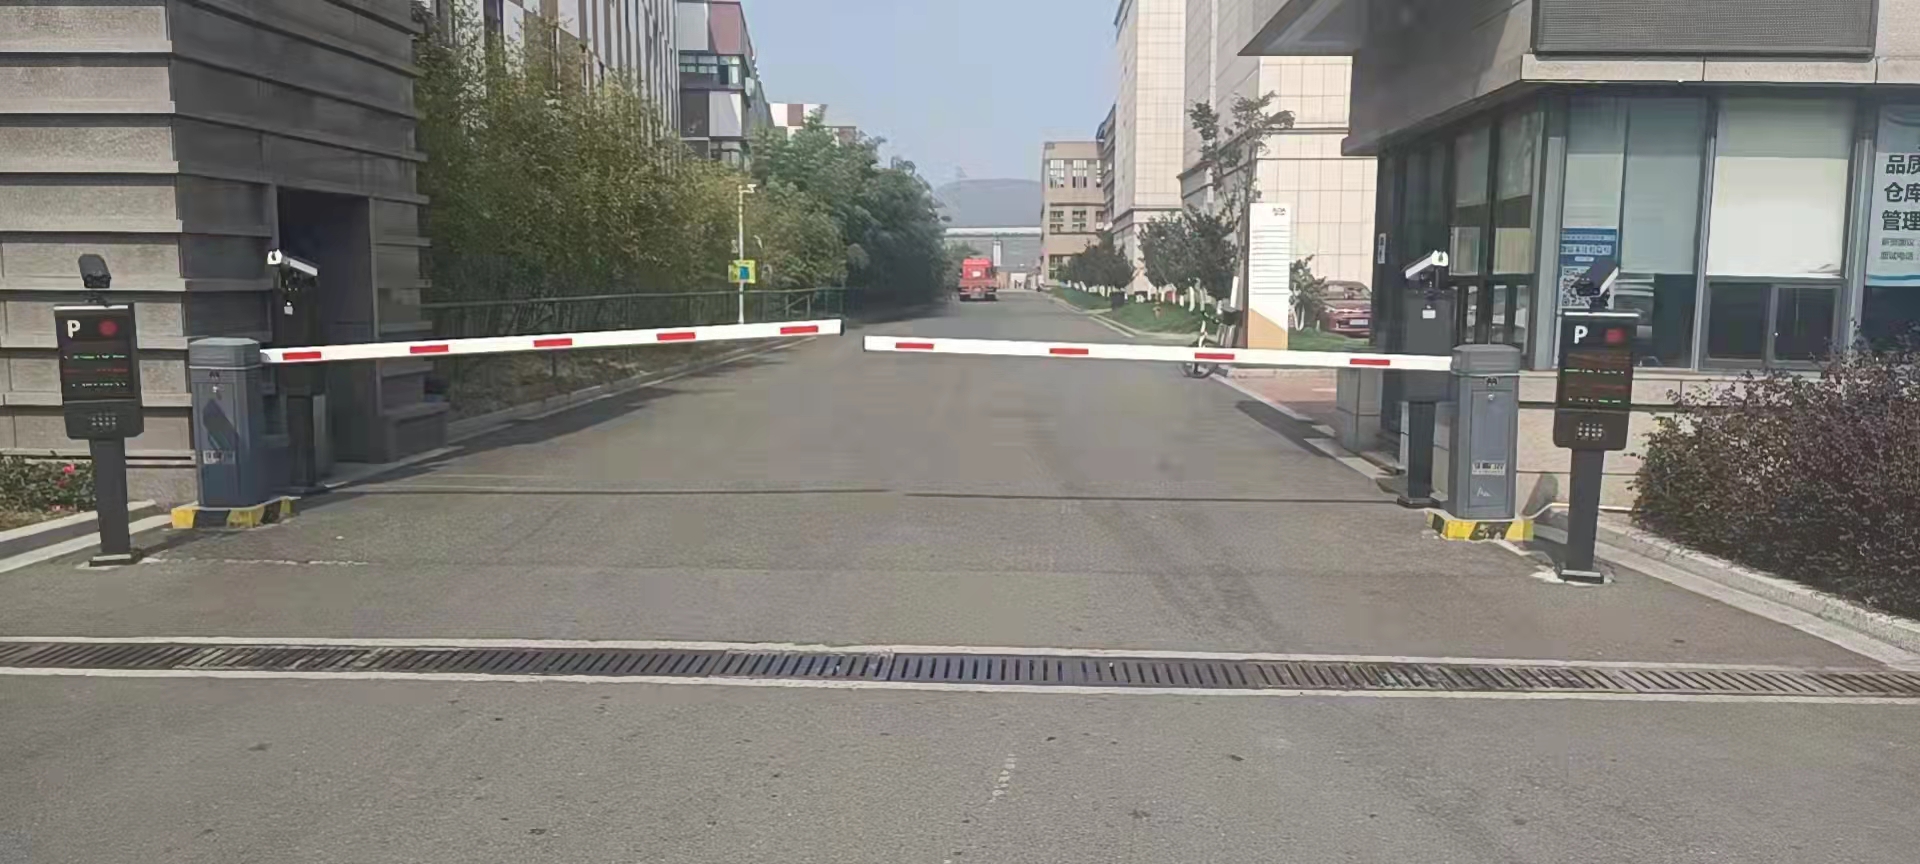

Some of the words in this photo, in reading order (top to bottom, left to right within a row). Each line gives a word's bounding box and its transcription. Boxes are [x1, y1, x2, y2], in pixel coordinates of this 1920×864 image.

[1885, 154, 1920, 175] 品质
[1884, 181, 1920, 203] 仓库
[1881, 210, 1920, 231] 管理
[66, 319, 81, 339] P
[1573, 325, 1589, 344] P
